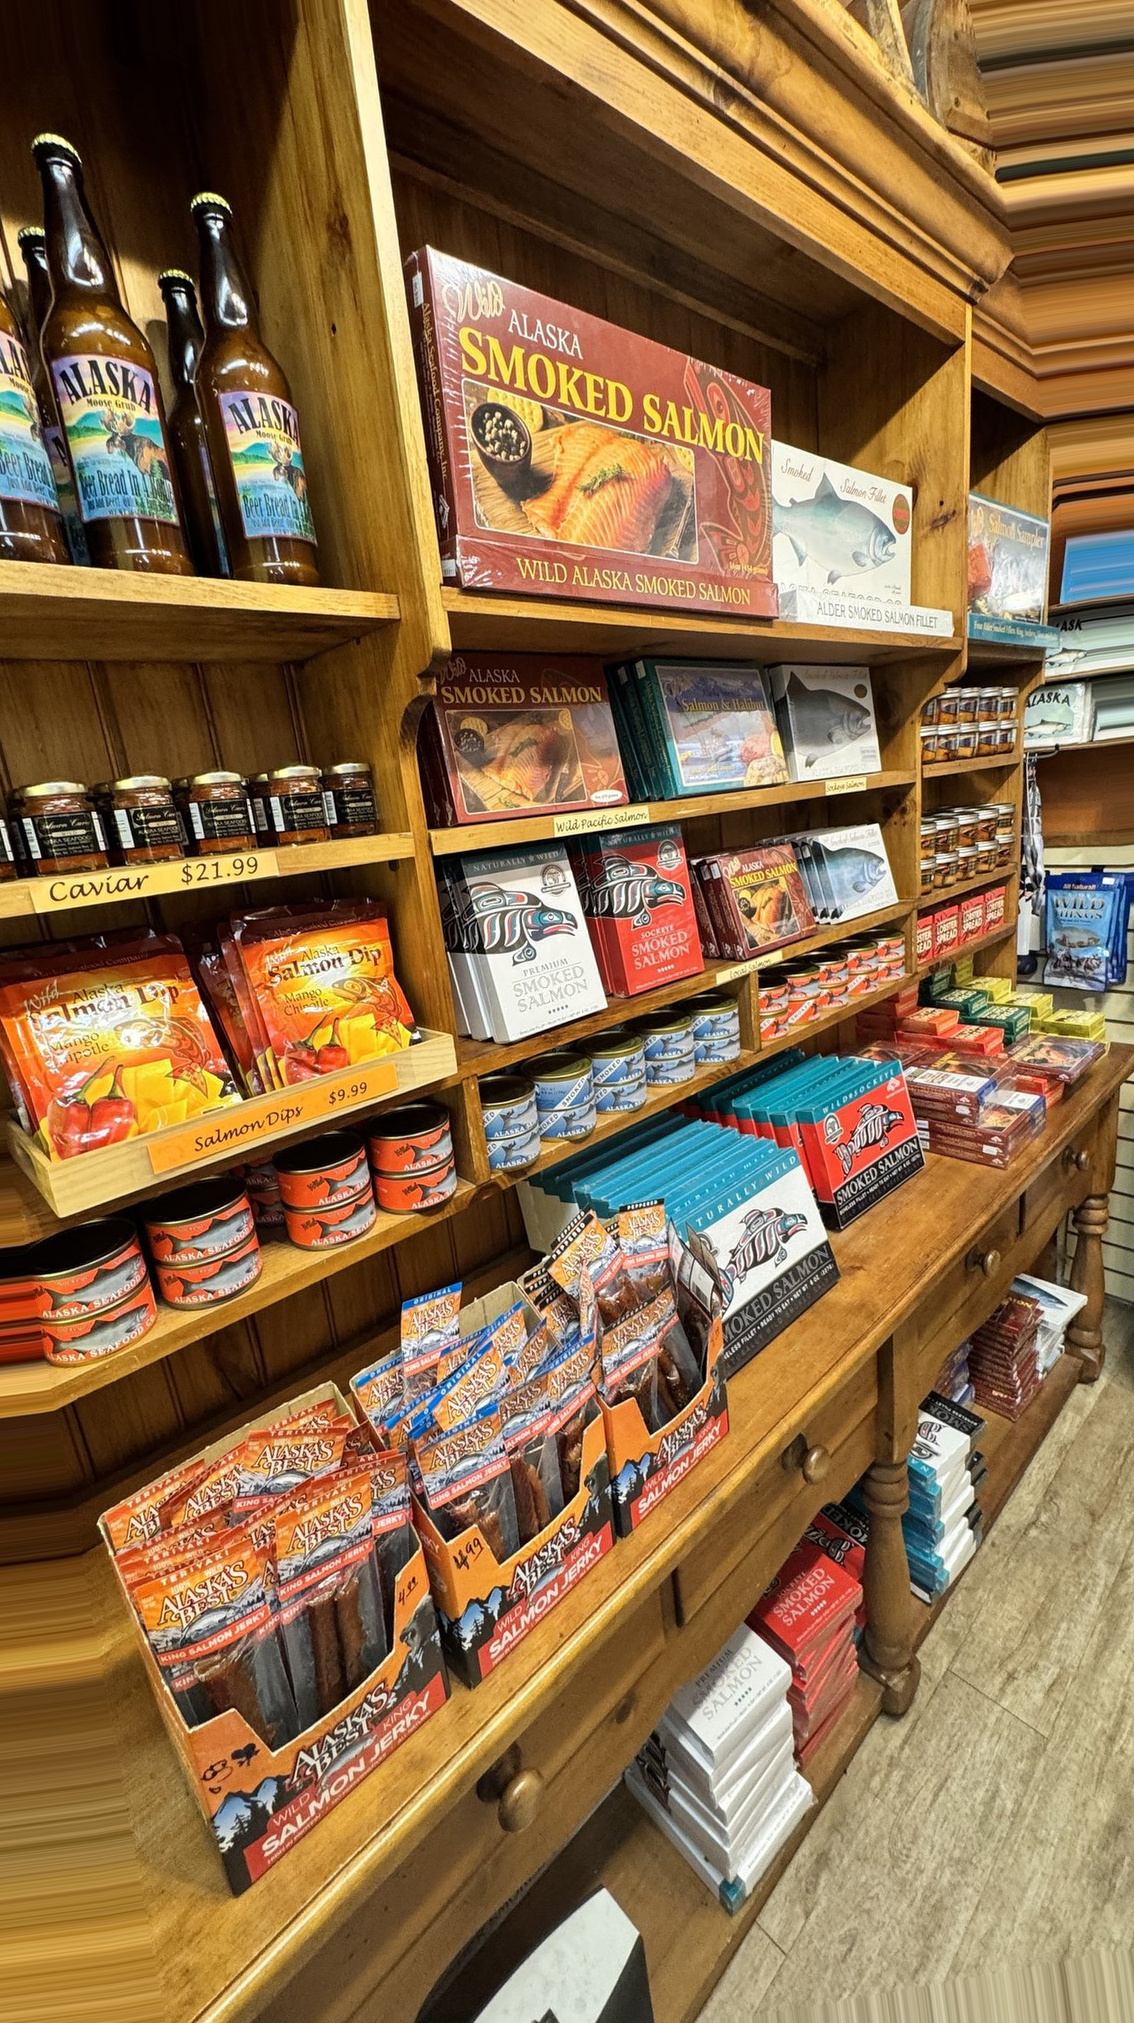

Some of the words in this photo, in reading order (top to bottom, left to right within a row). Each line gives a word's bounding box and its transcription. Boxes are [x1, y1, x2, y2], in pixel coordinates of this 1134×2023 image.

[442, 280, 504, 322] Wild
[508, 310, 583, 360] ALASKA
[59, 359, 152, 414] ALASKA
[459, 326, 634, 423] SMOKED
[643, 394, 764, 465] SALMON
[86, 397, 112, 408] Moose
[114, 399, 137, 413] Grub
[228, 397, 300, 446] ALASKA
[97, 469, 129, 497] Bread
[781, 458, 817, 483] Smoked
[840, 478, 868, 501] Salmon
[869, 485, 888, 504] Fillet
[517, 557, 567, 584] WILD
[572, 566, 633, 591] ALASKA
[635, 575, 696, 599] SMOKED
[699, 582, 751, 606] SALMON
[817, 601, 846, 617] ALDER
[848, 604, 883, 622] SMOKED
[884, 609, 915, 627] SALMON
[916, 612, 938, 629] FILLET
[469, 668, 520, 684] ALASKA
[440, 686, 526, 705] SMOKED
[529, 686, 602, 704] SALMON
[682, 698, 719, 713] Salmon
[722, 698, 731, 711] &
[732, 698, 766, 712] Halibut
[846, 779, 865, 790] Salmon
[556, 817, 579, 833] Wild
[580, 815, 613, 832] Pacific
[614, 811, 648, 826] Salmon
[473, 855, 528, 872] NATURALLY
[536, 850, 561, 862] WILD
[730, 869, 766, 889] SMOKED
[766, 862, 799, 879] SALMON
[742, 861, 765, 873] ALASKA
[49, 873, 150, 903] Caviar
[181, 856, 260, 886] $21.99
[962, 908, 983, 925] LOBSTER
[1053, 896, 1105, 910] WILD
[640, 923, 675, 940] SOCKEYE
[936, 929, 958, 946] SPREAD
[937, 919, 958, 936] LOBSTER
[962, 917, 982, 933] SPREAD
[300, 944, 341, 963] Alaska
[631, 930, 689, 958] SMOKED
[634, 944, 691, 971] SALMON
[268, 954, 344, 985] Salmon
[347, 945, 383, 969] Dip
[523, 957, 568, 978] PREMIUM
[729, 967, 748, 980] Local
[748, 958, 772, 974] Salmon
[72, 982, 125, 1005] Alaska
[284, 986, 323, 1005] Mango
[513, 965, 586, 998] SMOKED
[517, 978, 589, 1013] SALMON
[596, 1058, 621, 1083] SMOKED
[561, 1077, 587, 1108] SMOKED
[822, 1095, 848, 1114] WILD
[852, 1068, 895, 1097] SOCKEYE
[194, 1117, 266, 1153] Salmon
[265, 1104, 305, 1128] Dips
[328, 1081, 369, 1105] $9.99
[494, 1123, 526, 1138] ALASKA
[556, 1125, 587, 1138] ALASKA
[403, 1157, 438, 1171] ALASKA
[495, 1158, 529, 1170] ALASKA
[764, 1155, 796, 1181] WILD
[836, 1167, 878, 1206] SMOKED
[877, 1138, 919, 1174] SALMON
[318, 1188, 356, 1206] ALASKA
[411, 1194, 444, 1210] ALASKA
[627, 1199, 658, 1211] PEPPERED
[311, 1233, 350, 1247] ALASKA
[552, 1222, 587, 1260] PEPPERED
[557, 1210, 586, 1243] PEPPERED
[163, 1250, 204, 1263] ALASKA
[206, 1228, 251, 1255] SEAFOOD
[174, 1293, 215, 1304] ALASKA
[217, 1265, 261, 1298] SEAFOOD
[772, 1245, 830, 1300] SALMON
[42, 1304, 91, 1319] ALASKA
[92, 1277, 143, 1309] SEAFOOD
[413, 1287, 452, 1305] ORIGINAL
[407, 1298, 455, 1335] ALASKA'S
[740, 1327, 757, 1343] FILLET
[760, 1313, 775, 1328] READY
[89, 1325, 145, 1359] SEAFOOD
[440, 1351, 483, 1396] ORIGINAL
[447, 1356, 498, 1423] ALASKA'S
[270, 1428, 328, 1437] TERIYAKI
[430, 1420, 495, 1469] ALASKA'S
[251, 1439, 336, 1469] ALASKA'S
[262, 1459, 313, 1479] BEST
[637, 1457, 690, 1514] SALMON
[690, 1420, 722, 1463] JERKY
[295, 1481, 352, 1515] TERIYAKI
[430, 1489, 450, 1505] KING
[451, 1472, 483, 1494] SALMON
[484, 1460, 509, 1477] JERKY
[235, 1499, 260, 1509] KING
[286, 1493, 363, 1555] ALASKA'S
[376, 1513, 404, 1530] JERKY
[161, 1549, 230, 1587] TERIYAKI
[280, 1580, 303, 1597] KING
[304, 1557, 342, 1582] SALMON
[343, 1541, 371, 1561] JERKY
[509, 1517, 575, 1596] ALASKA'S
[157, 1559, 248, 1626] ALASKA'S
[489, 1581, 560, 1660] SALMON
[561, 1535, 603, 1590] JERKY
[497, 1605, 523, 1632] WILD
[570, 1536, 590, 1562] KING
[773, 1567, 826, 1619] SMOKED
[782, 1575, 836, 1627] SALMON
[160, 1651, 187, 1663] KING
[188, 1629, 234, 1652] SALMON
[233, 1608, 267, 1634] JERKY
[695, 1649, 733, 1688] PREMIUM
[702, 1655, 763, 1721] SALMON
[289, 1682, 389, 1786] ALASKA'S
[305, 1716, 375, 1780] BEST
[261, 1756, 367, 1858] SALMON
[369, 1690, 430, 1763] JERKY
[273, 1792, 311, 1827] WILD
[382, 1698, 413, 1732] KING
